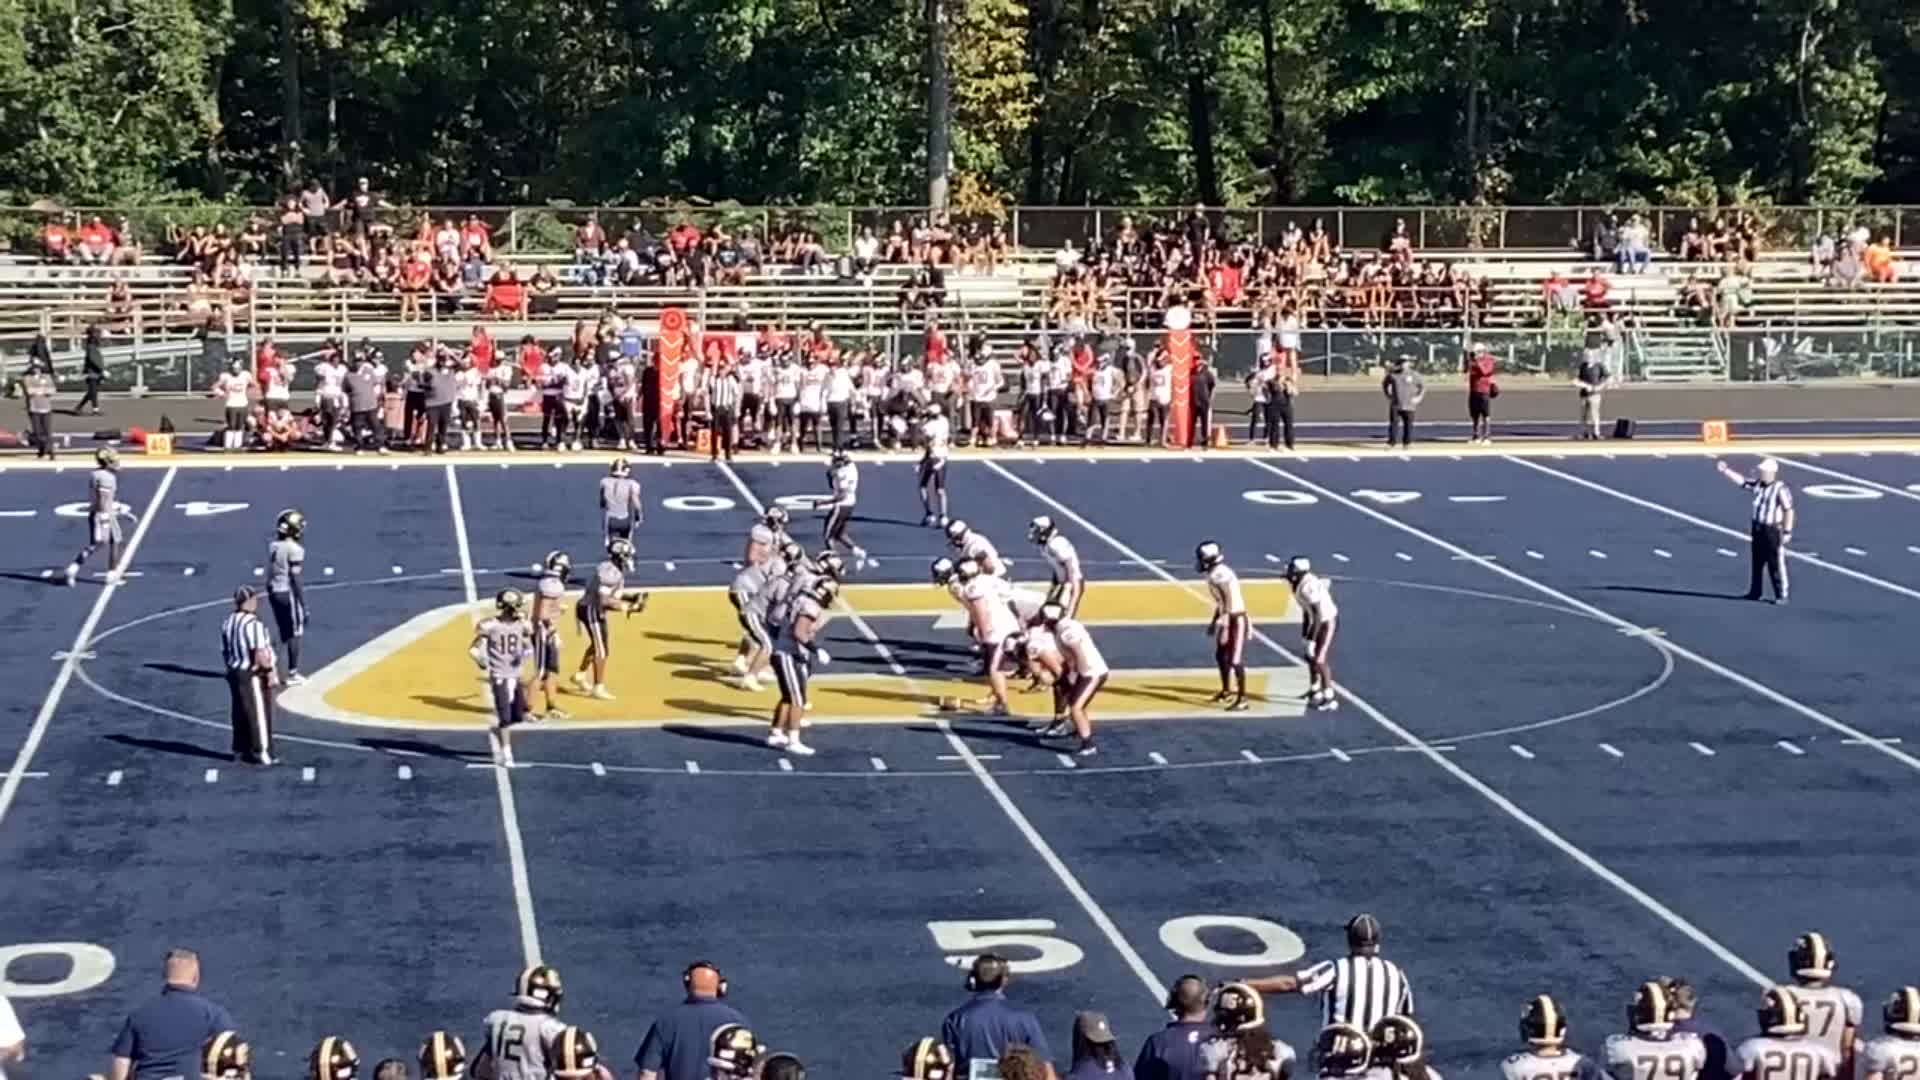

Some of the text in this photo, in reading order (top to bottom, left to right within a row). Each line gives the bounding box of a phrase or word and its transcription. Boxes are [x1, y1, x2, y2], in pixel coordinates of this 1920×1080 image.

[498, 633, 518, 656] 18
[497, 1019, 526, 1062] 12
[1637, 1055, 1682, 1080] 79
[1764, 1050, 1813, 1080] 20
